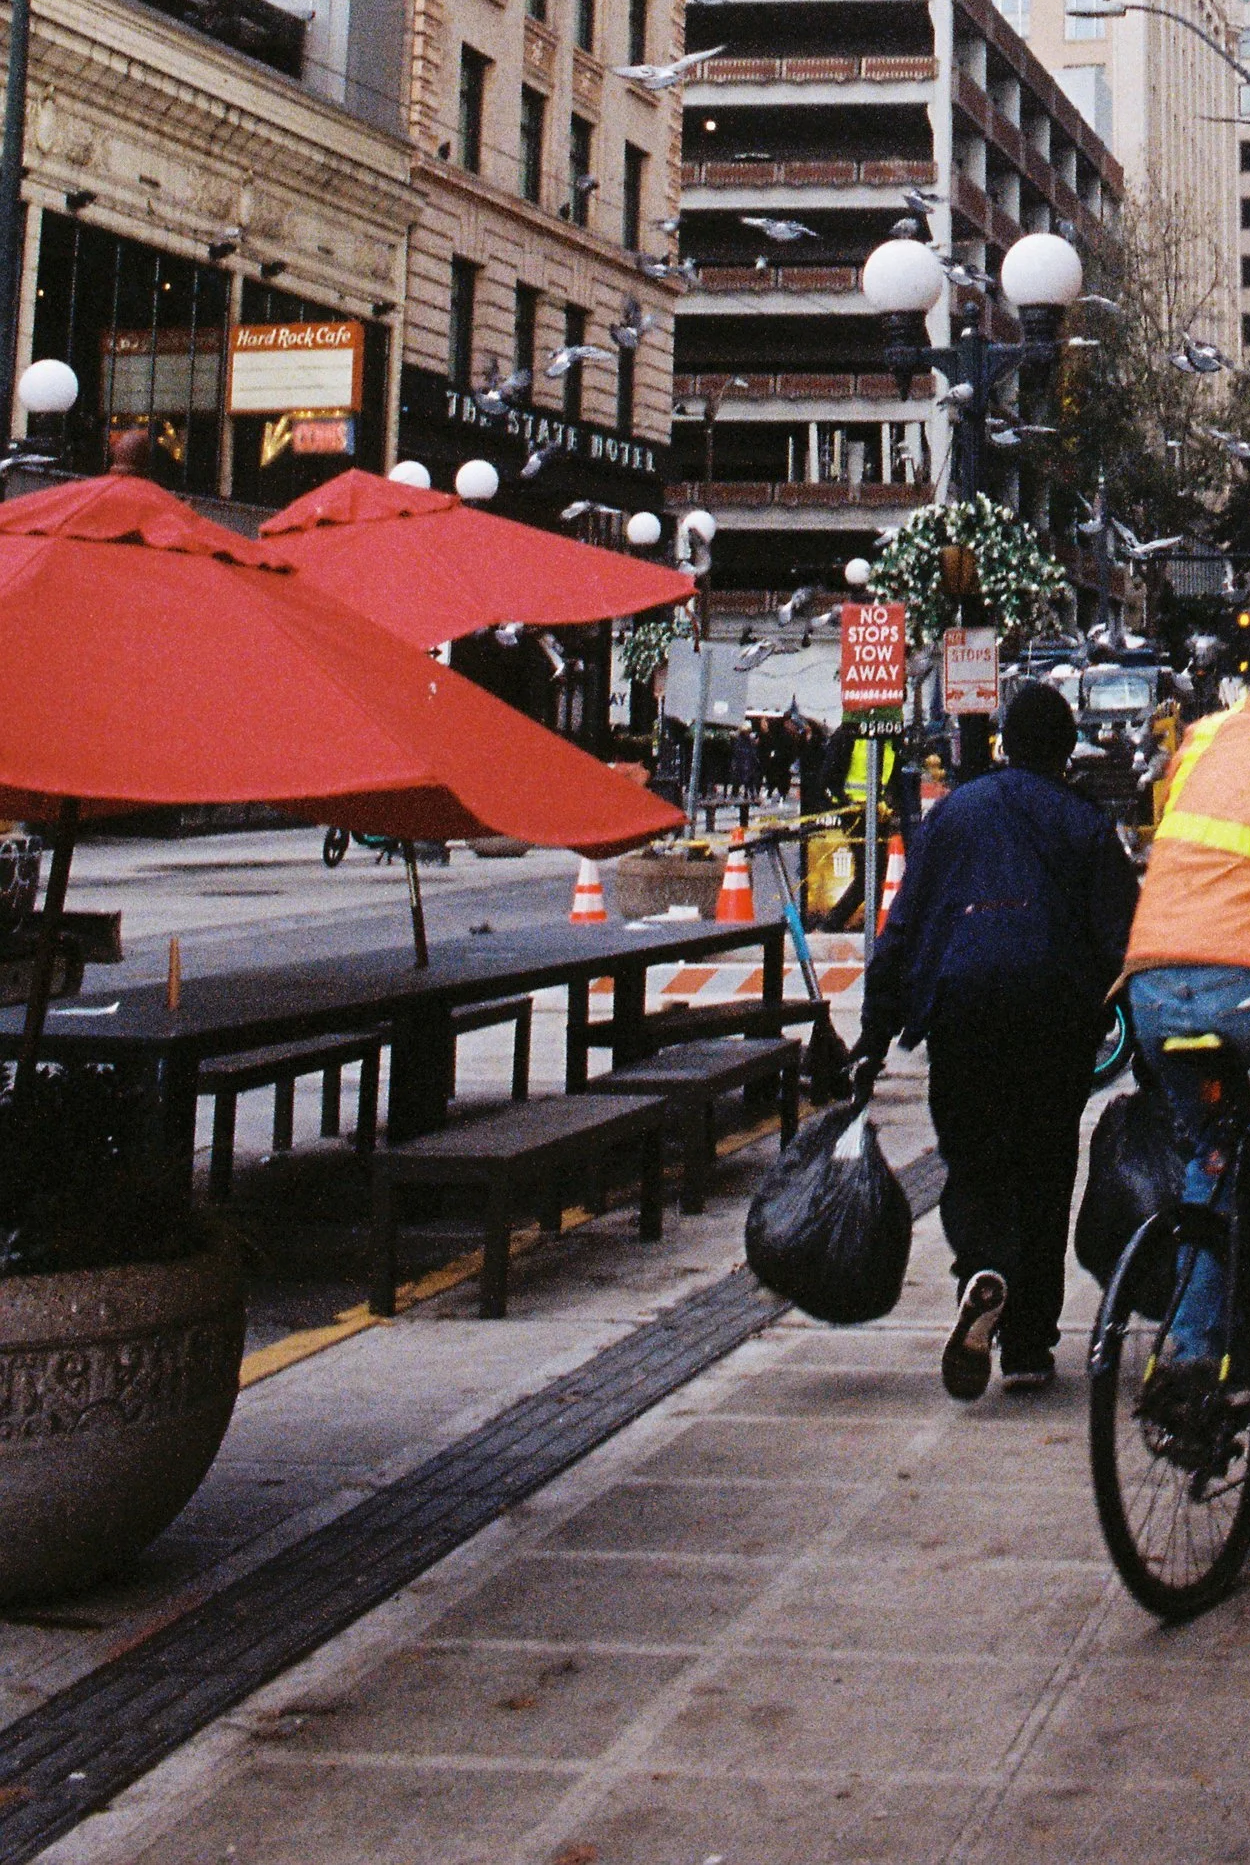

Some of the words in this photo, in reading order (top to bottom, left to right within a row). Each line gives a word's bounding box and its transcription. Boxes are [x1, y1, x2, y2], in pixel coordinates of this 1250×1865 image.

[237, 330, 276, 347] Hard
[278, 329, 314, 346] Rock
[316, 327, 352, 344] Cafe
[591, 434, 656, 473] HOTEL
[860, 608, 889, 625] NO
[848, 626, 900, 643] STOPS
[854, 645, 894, 662] TOW
[951, 647, 992, 663] STOPS
[845, 665, 900, 683] AWAY
